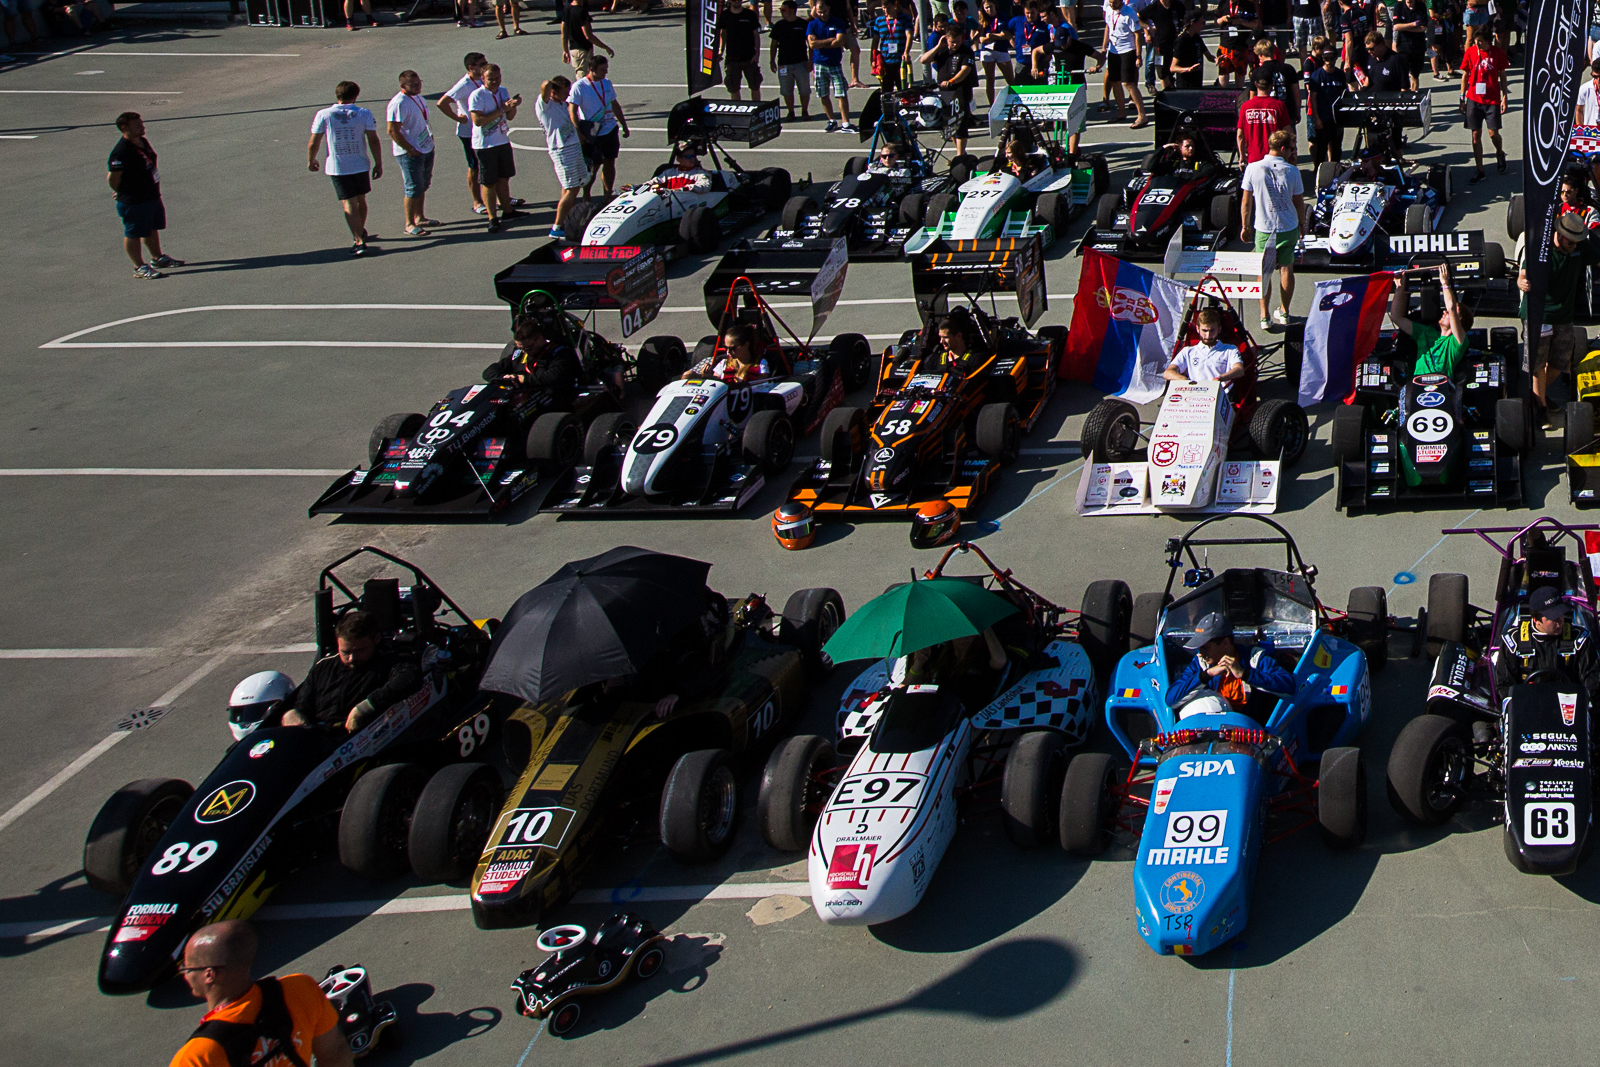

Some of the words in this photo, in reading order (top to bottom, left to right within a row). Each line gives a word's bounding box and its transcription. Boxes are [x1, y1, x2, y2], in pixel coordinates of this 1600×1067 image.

[765, 106, 780, 124] E90
[966, 190, 1003, 200] 297
[1143, 194, 1169, 204] 90
[1349, 186, 1371, 195] 92
[601, 205, 637, 215] E90
[830, 197, 861, 209] 78
[1389, 233, 1470, 253] MAHLE
[622, 307, 643, 337] 04
[729, 387, 751, 413] 79
[429, 409, 476, 428] 04
[881, 419, 912, 436] 58
[1412, 416, 1449, 433] 69
[636, 424, 674, 448] 79
[1271, 572, 1294, 584] TSR
[1451, 653, 1468, 686] SEGULA
[752, 702, 773, 739] 10
[458, 713, 491, 758] 89
[1547, 743, 1578, 752] ANSYS
[580, 749, 620, 813] DORTMUND
[832, 777, 922, 807] E97
[507, 810, 554, 844] 10
[1171, 814, 1221, 844] 99
[1530, 807, 1569, 839] 63
[151, 839, 219, 876] 89
[496, 849, 533, 862] ADAC
[1146, 846, 1230, 866] MAHLE
[482, 869, 529, 882] STUDENT
[486, 860, 533, 873] FORMULA
[201, 894, 224, 918] STU
[221, 835, 274, 896] BRATISLAVA
[127, 903, 179, 916] FORMULA
[121, 914, 173, 927] STUDENT
[1163, 913, 1194, 931] TSR
